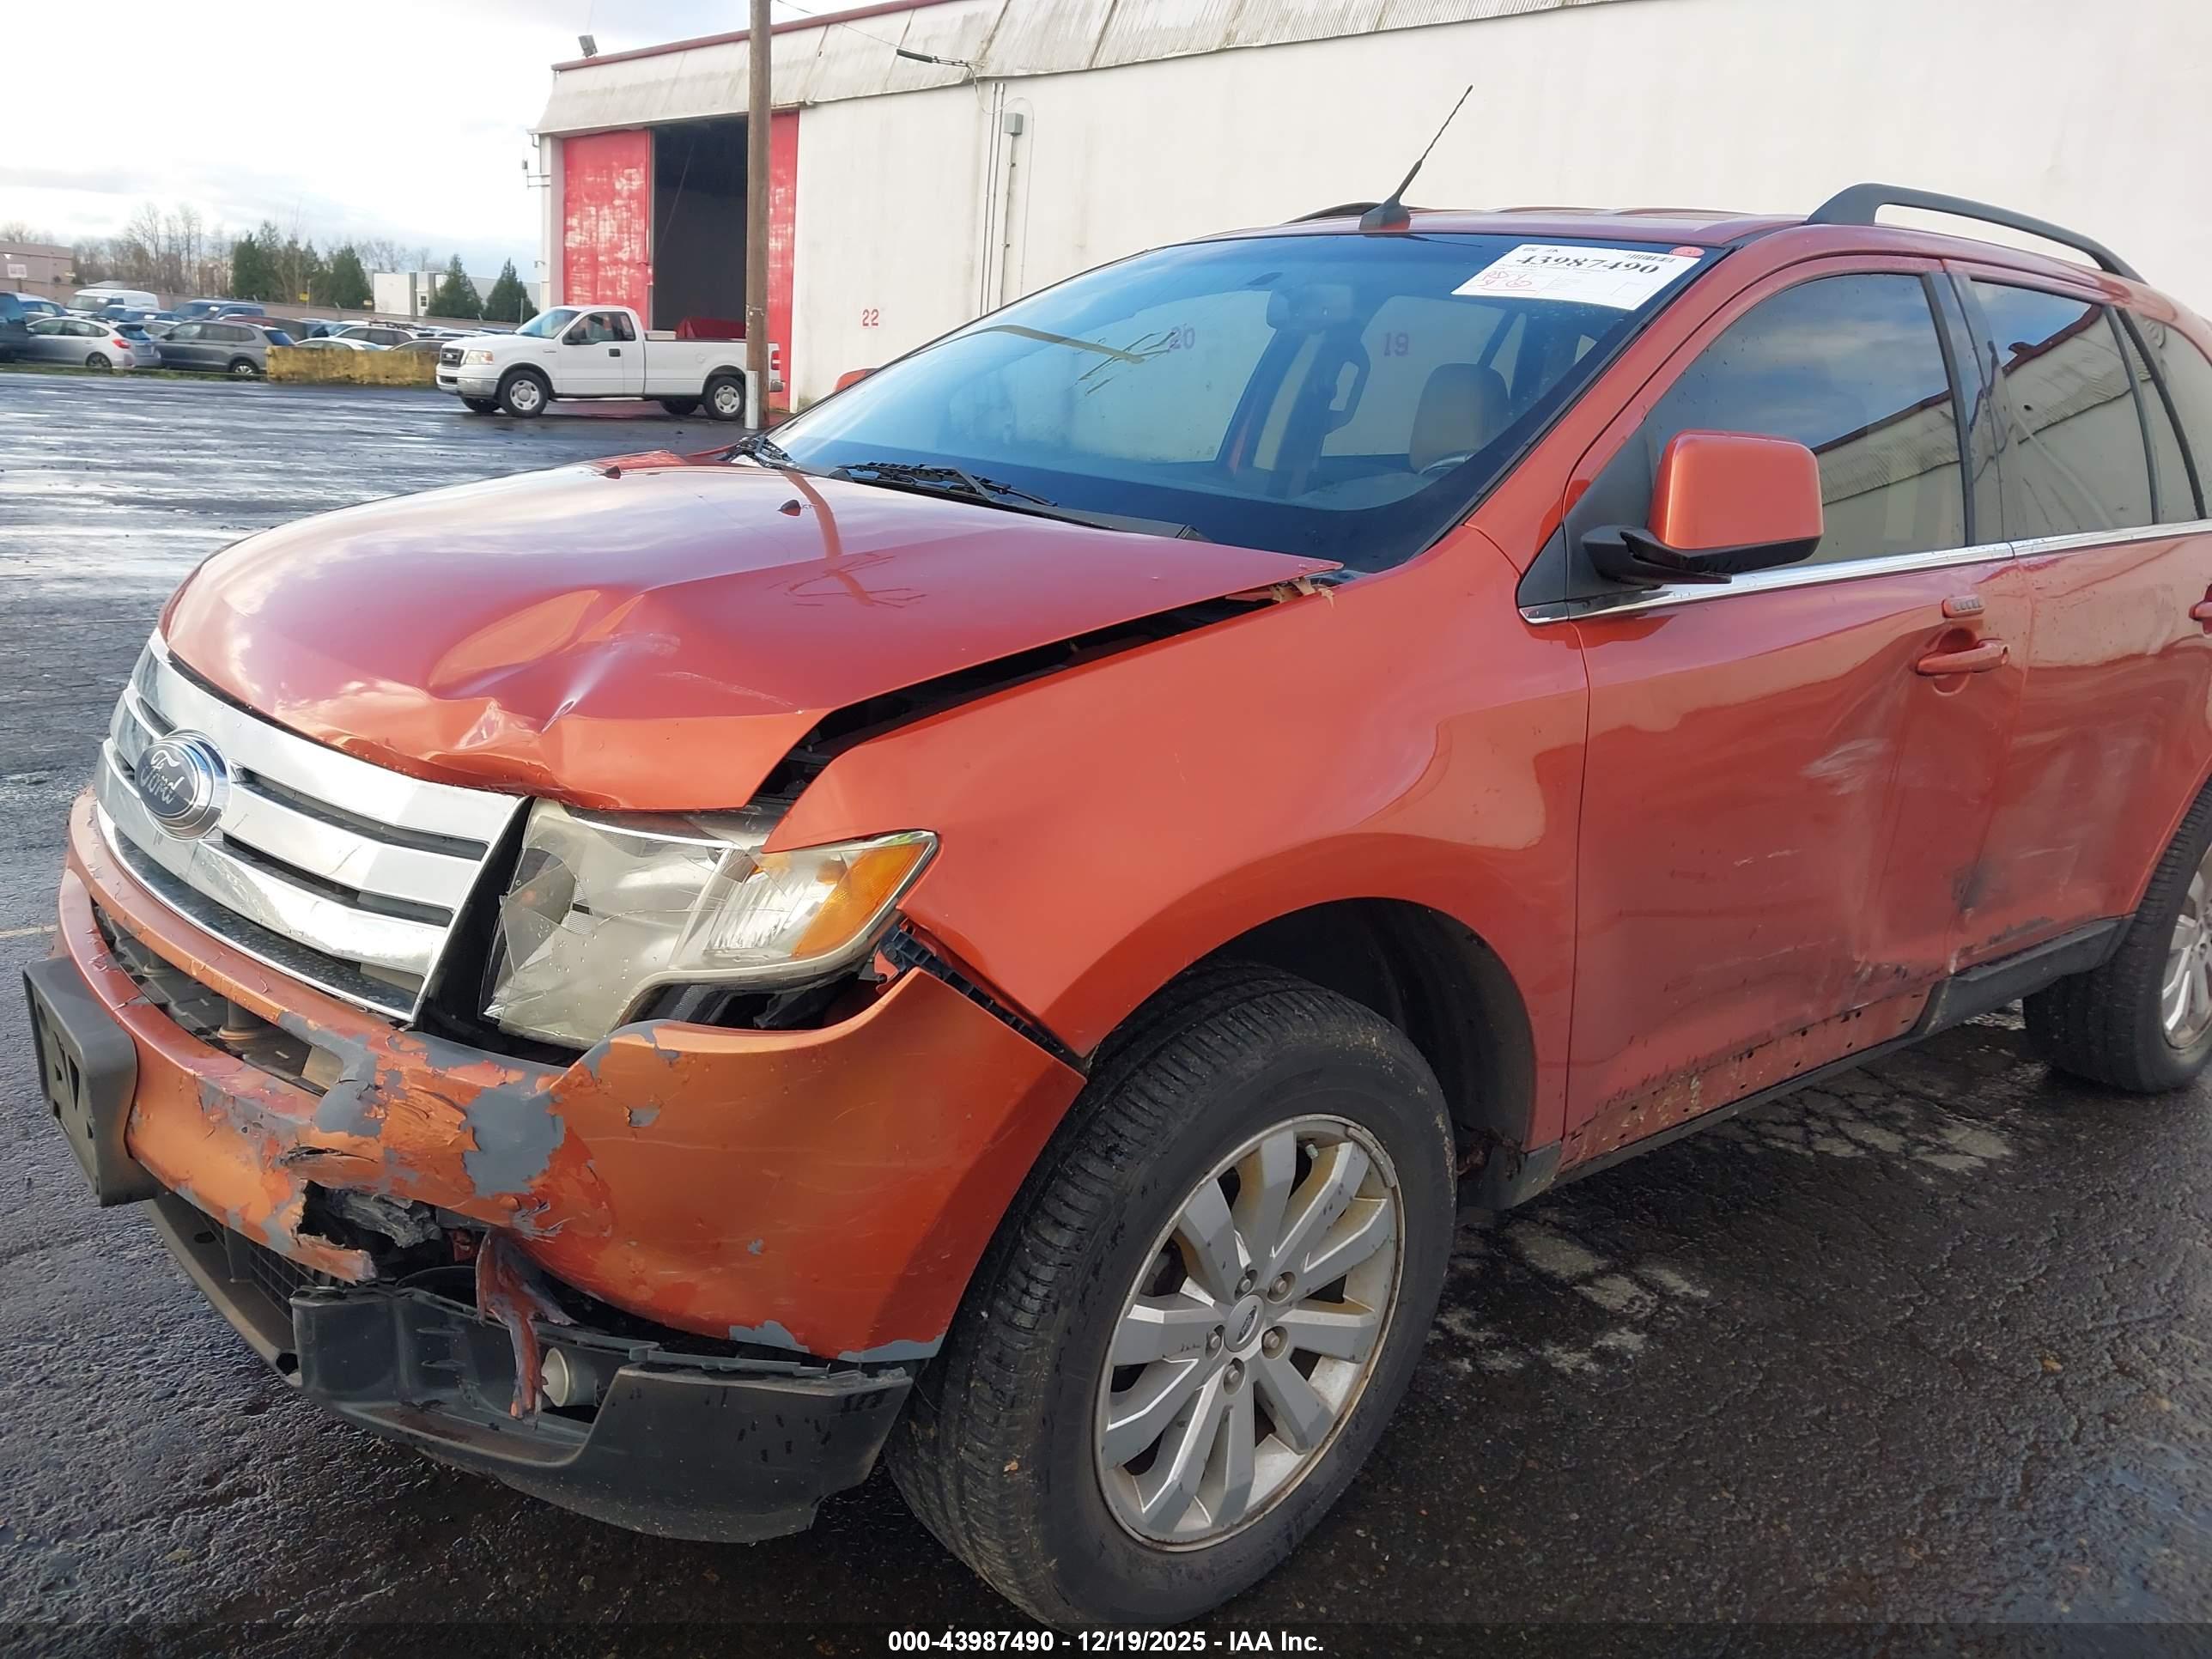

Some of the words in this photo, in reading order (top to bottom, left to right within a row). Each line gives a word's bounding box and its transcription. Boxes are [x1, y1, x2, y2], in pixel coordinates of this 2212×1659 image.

[1516, 254, 1660, 274] 43987490
[861, 308, 879, 327] 22
[1169, 326, 1195, 350] 20
[1383, 331, 1409, 357] 19
